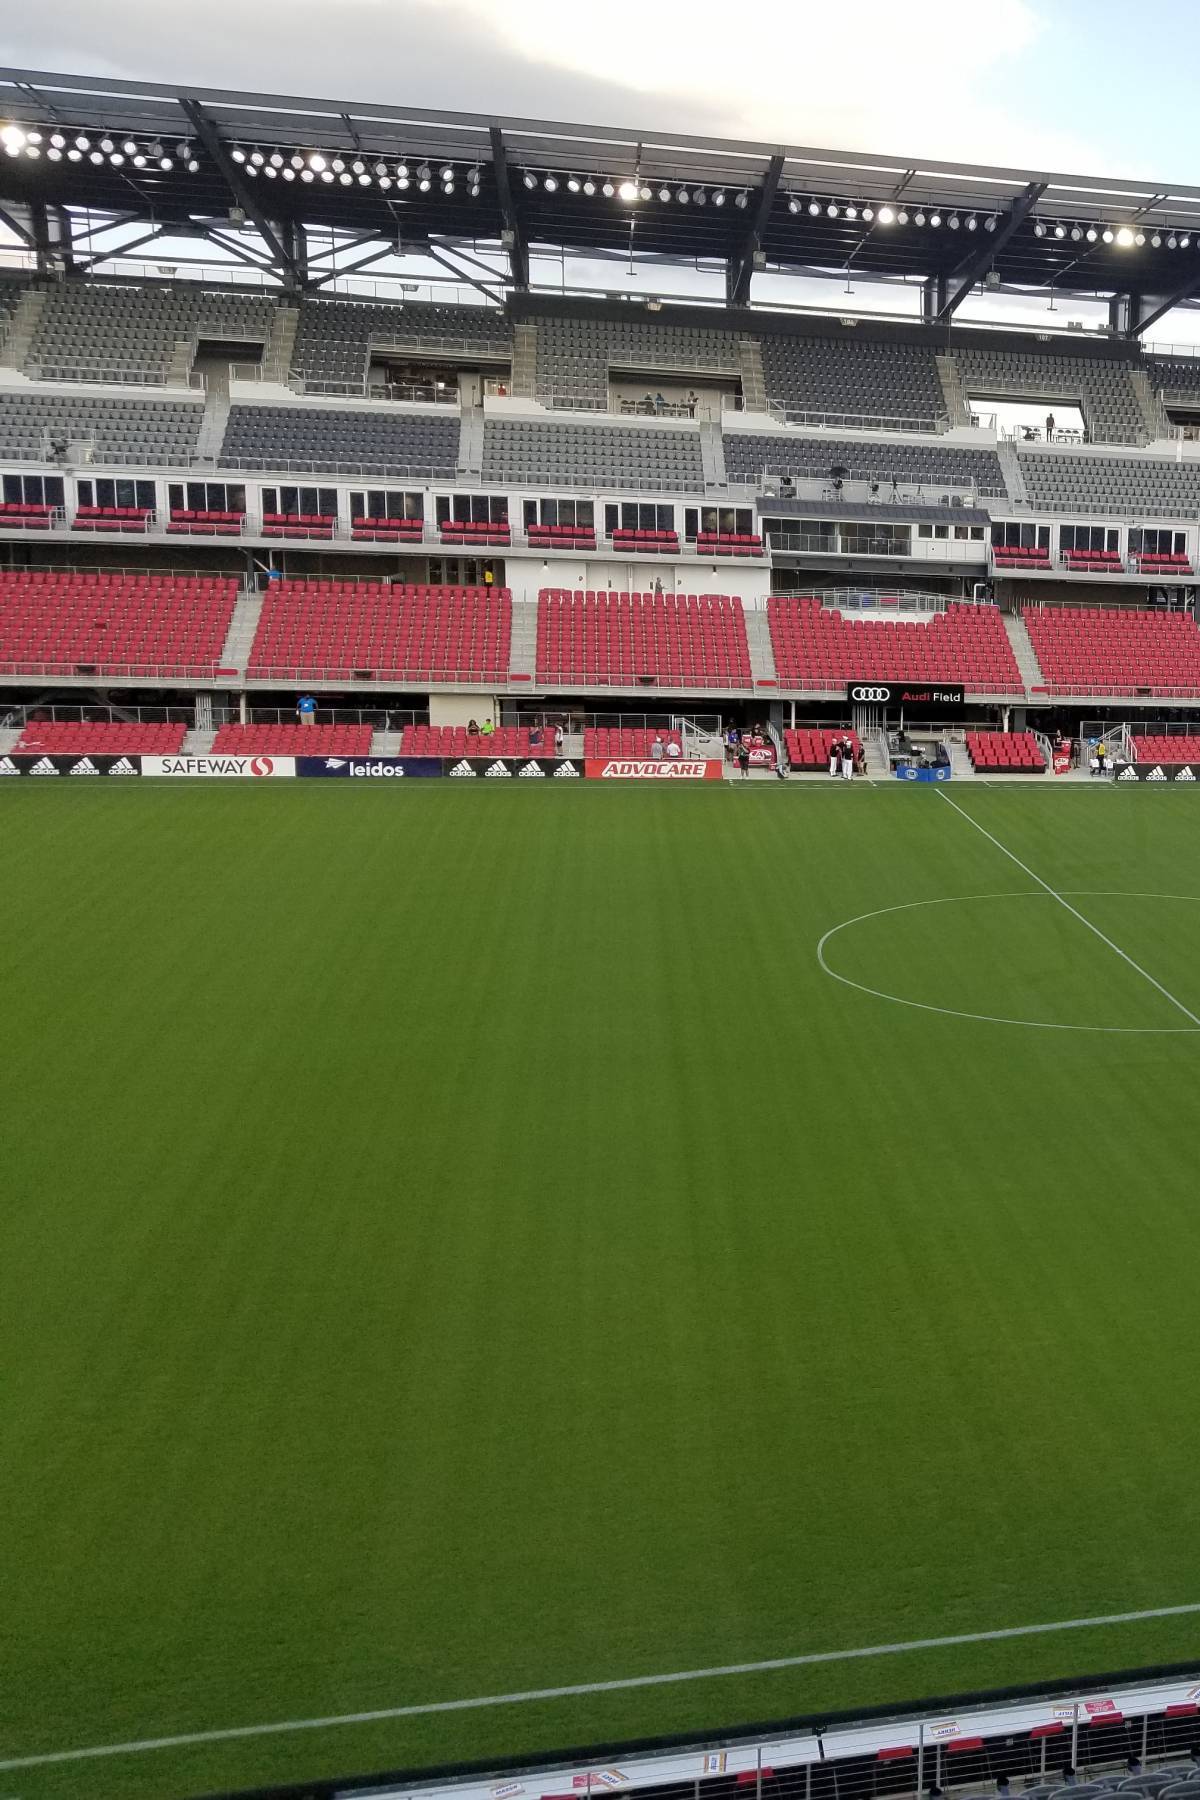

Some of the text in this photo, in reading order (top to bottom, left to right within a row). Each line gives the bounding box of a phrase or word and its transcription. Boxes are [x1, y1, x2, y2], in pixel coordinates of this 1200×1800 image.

[902, 692, 961, 702] Audi Field
[162, 759, 247, 774] SAFEWAY
[350, 761, 404, 777] leidos
[602, 761, 706, 777] ADVOCARE
[29, 768, 60, 776] adidas
[69, 768, 100, 776] adidas
[108, 768, 138, 776] adidas
[449, 769, 477, 777] adidas
[484, 769, 512, 777] adidas
[518, 769, 546, 777] adidas
[553, 769, 580, 777] adidas
